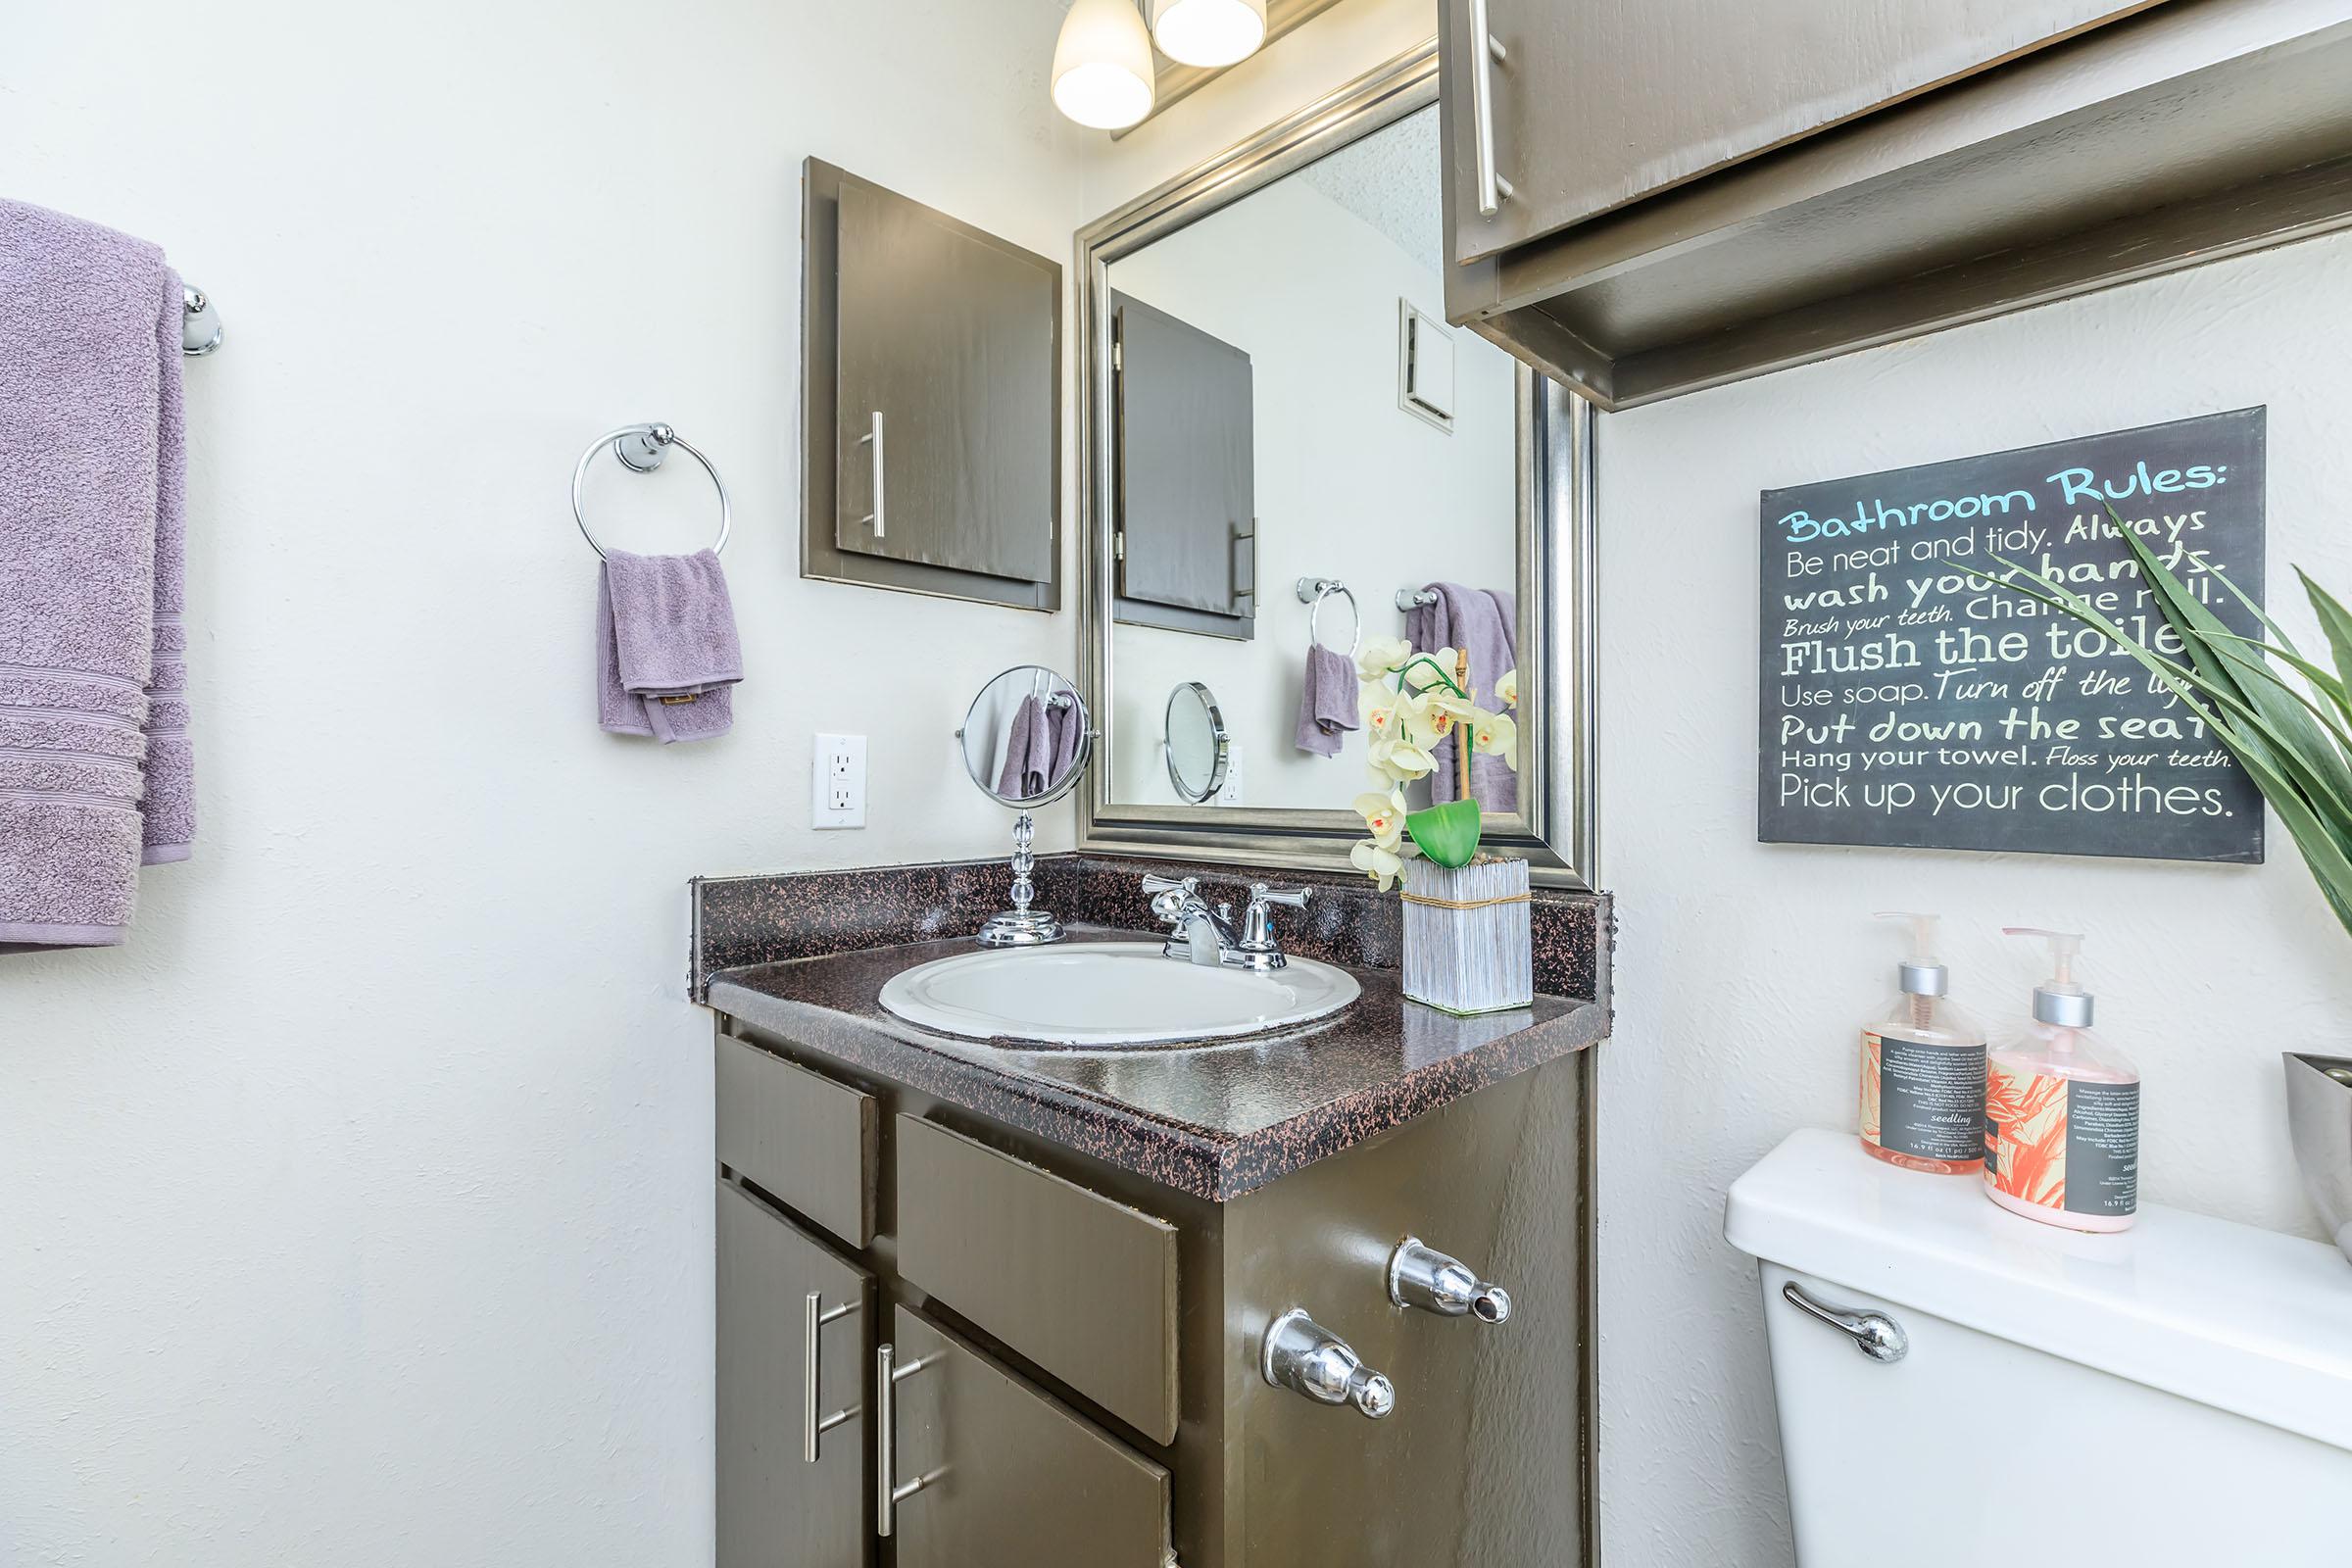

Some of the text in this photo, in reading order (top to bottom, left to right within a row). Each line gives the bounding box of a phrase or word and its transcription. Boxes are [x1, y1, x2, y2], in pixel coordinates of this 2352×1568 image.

[1778, 461, 2227, 542] Bathroom Rules:
[1788, 511, 2207, 577] Be neat and tidy. Always
[1783, 577, 2225, 640] Brush your teeth. Change rll.
[1784, 572, 1888, 611] wash
[1906, 567, 2020, 609] your
[1780, 615, 2187, 675] Flush the toile
[1782, 685, 1833, 707] Use
[1842, 683, 1930, 706] soap.
[1933, 667, 2008, 700] Turn
[2022, 665, 2068, 702] off
[2079, 669, 2132, 696] the
[1781, 704, 2221, 746] Put down the seat
[1781, 745, 2232, 774] Hang your towel. Floss your teeth.
[1781, 771, 2233, 817] Pick up your clothes.
[1931, 1113, 1971, 1126] seedling
